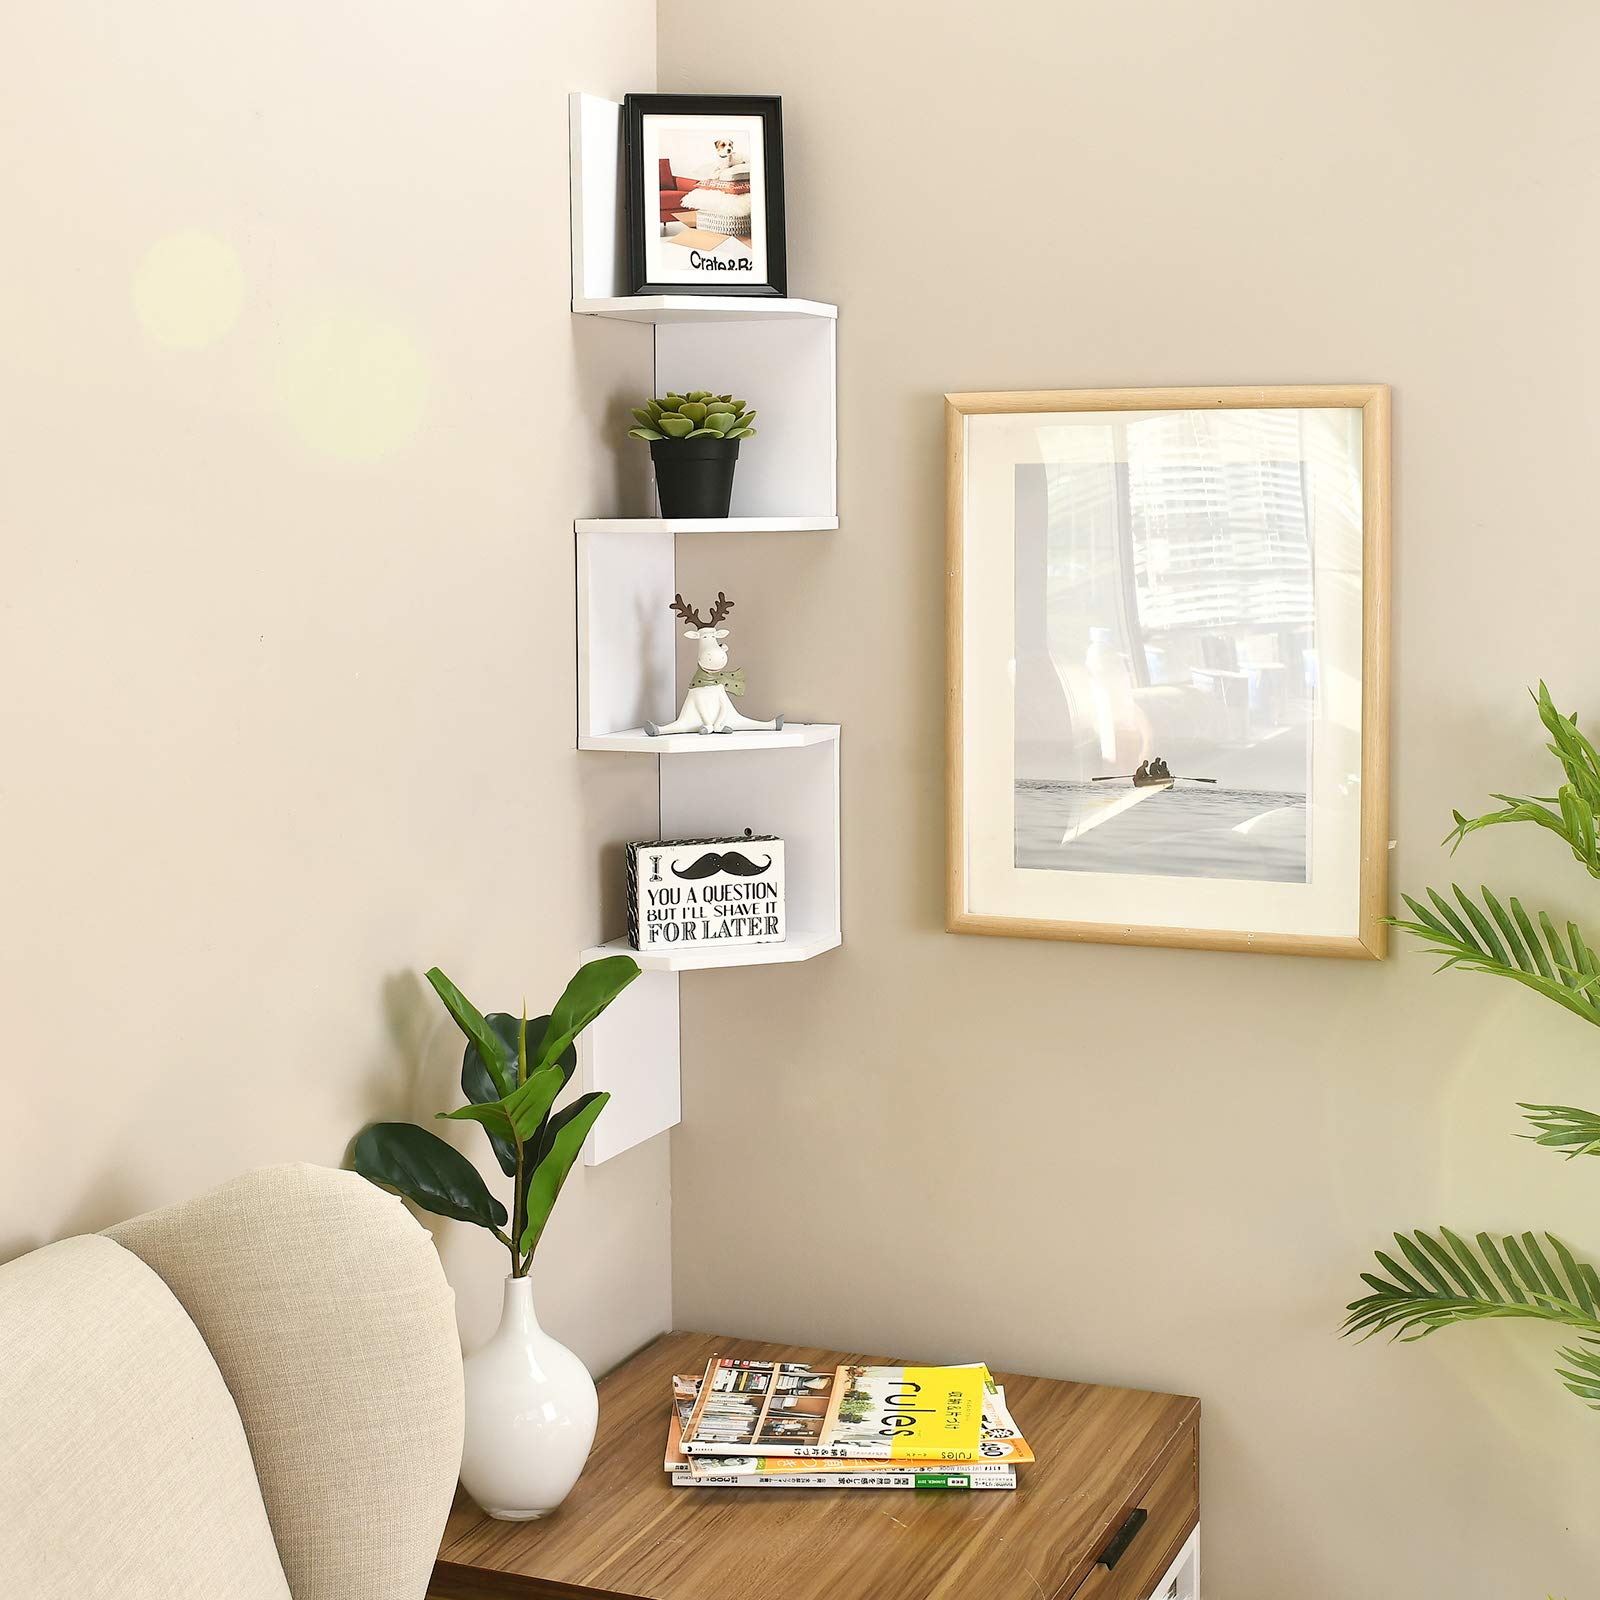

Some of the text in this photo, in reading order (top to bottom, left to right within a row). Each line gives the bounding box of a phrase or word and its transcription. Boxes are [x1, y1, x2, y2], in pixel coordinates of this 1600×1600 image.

[649, 855, 663, 882] I
[647, 882, 778, 906] YOU A QUESTION
[647, 901, 778, 922] BUT I'LL SHAVE IT
[647, 915, 780, 944] FOR LATER
[879, 1381, 937, 1438] rules
[941, 1452, 972, 1461] rules
